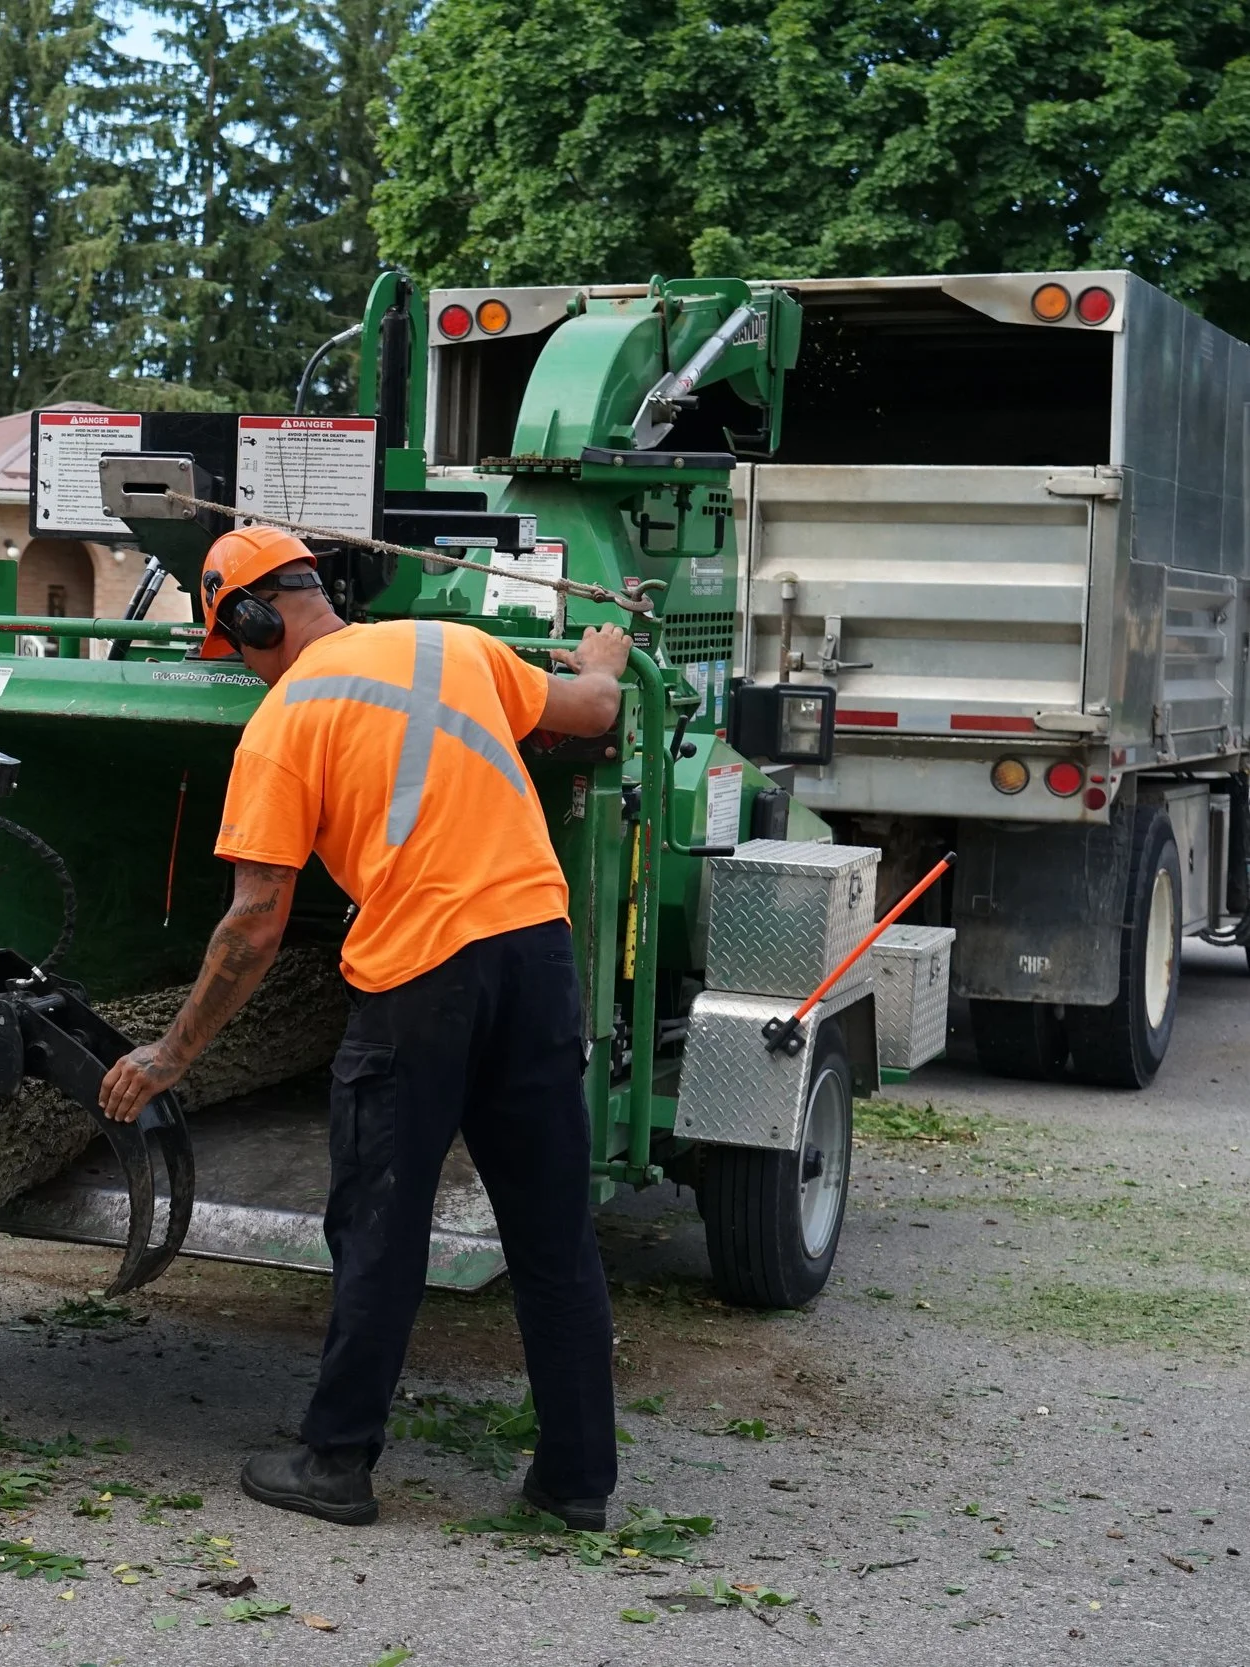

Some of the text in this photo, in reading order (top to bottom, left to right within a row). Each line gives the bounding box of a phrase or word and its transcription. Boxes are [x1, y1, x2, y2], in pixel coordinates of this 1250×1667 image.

[78, 416, 109, 425] DANGER
[292, 420, 334, 429] DANGER
[152, 671, 268, 686] www.banditchippe
